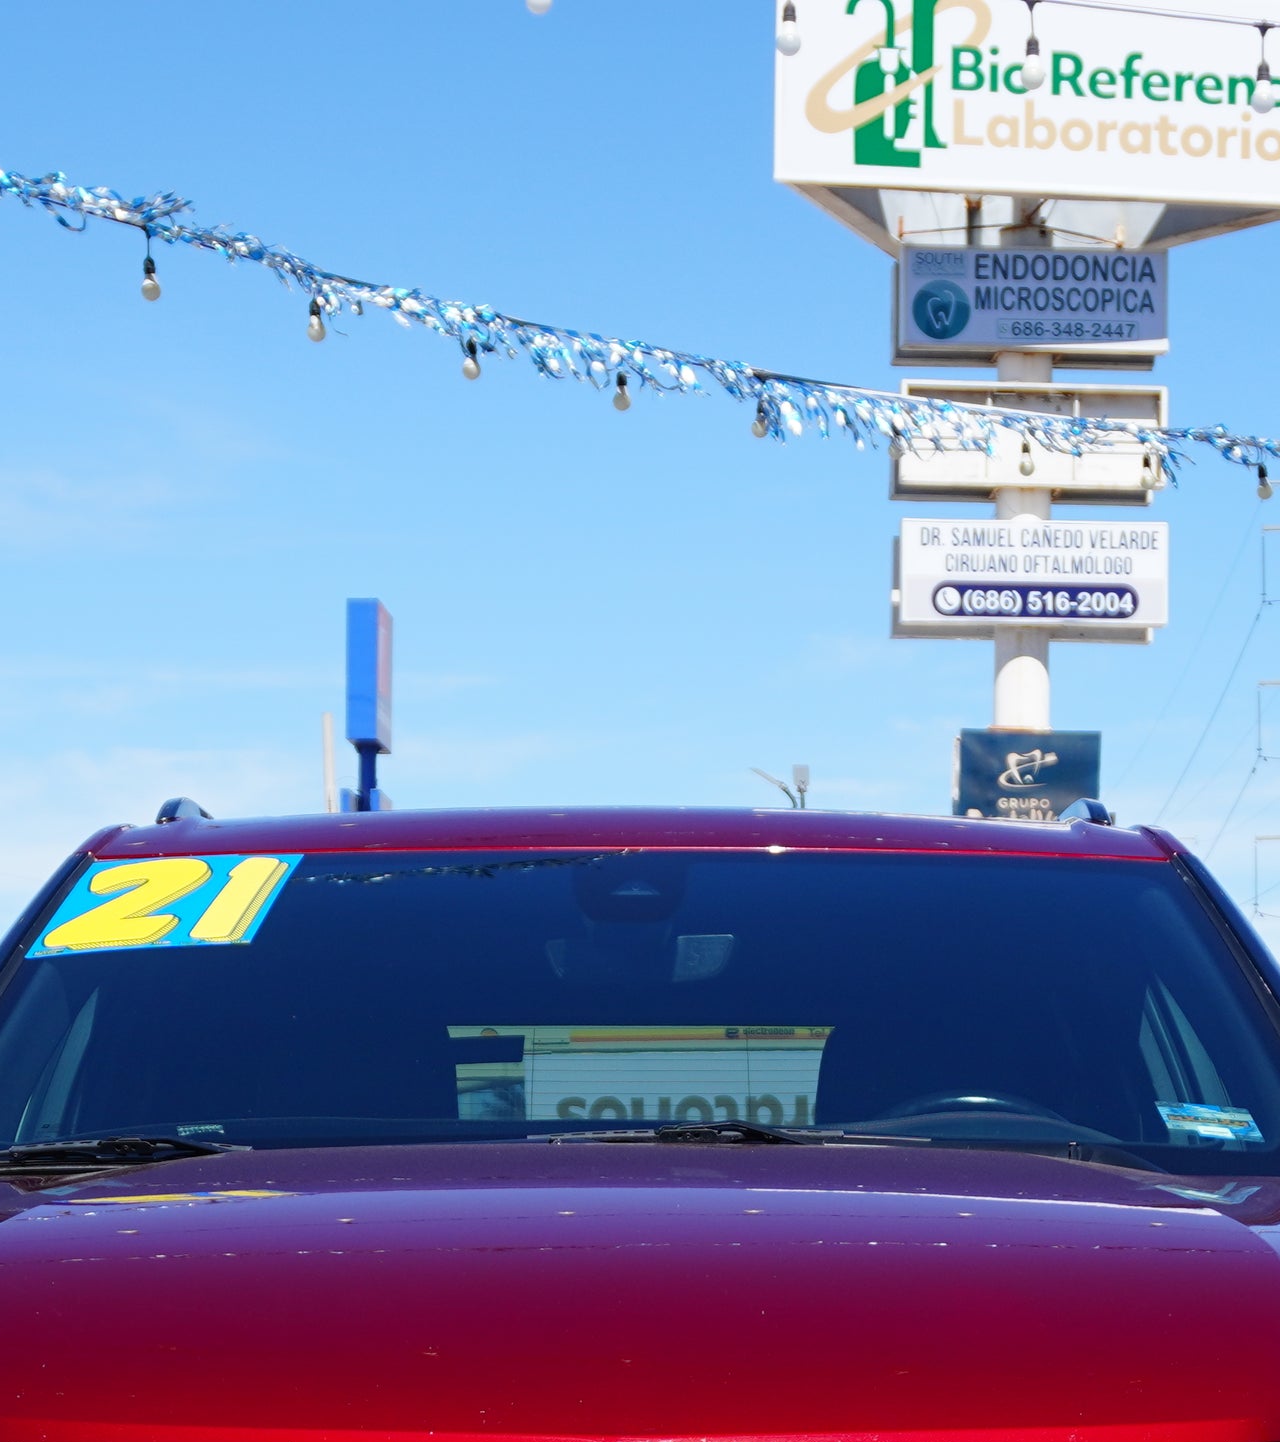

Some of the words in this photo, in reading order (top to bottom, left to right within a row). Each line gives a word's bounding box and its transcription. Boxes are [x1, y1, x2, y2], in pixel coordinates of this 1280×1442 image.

[951, 44, 1032, 95] Bio
[915, 251, 964, 265] SOUTH
[974, 253, 1156, 283] ENDODONCIA
[974, 286, 1155, 313] MICROSCOPICA
[1011, 321, 1136, 337] 686-348-2447
[920, 526, 945, 547] DR.
[951, 527, 1015, 548] SAMUEL
[1020, 525, 1083, 549] CAÑEDO
[1090, 530, 1160, 550] VELARDE
[945, 553, 1018, 573] CIRUJANO
[1023, 552, 1133, 575] OFTALMÓLOGO
[963, 588, 1022, 616] (686)
[1027, 590, 1134, 616] 516-2004
[998, 797, 1050, 809] GRUPO
[42, 857, 290, 951] 21
